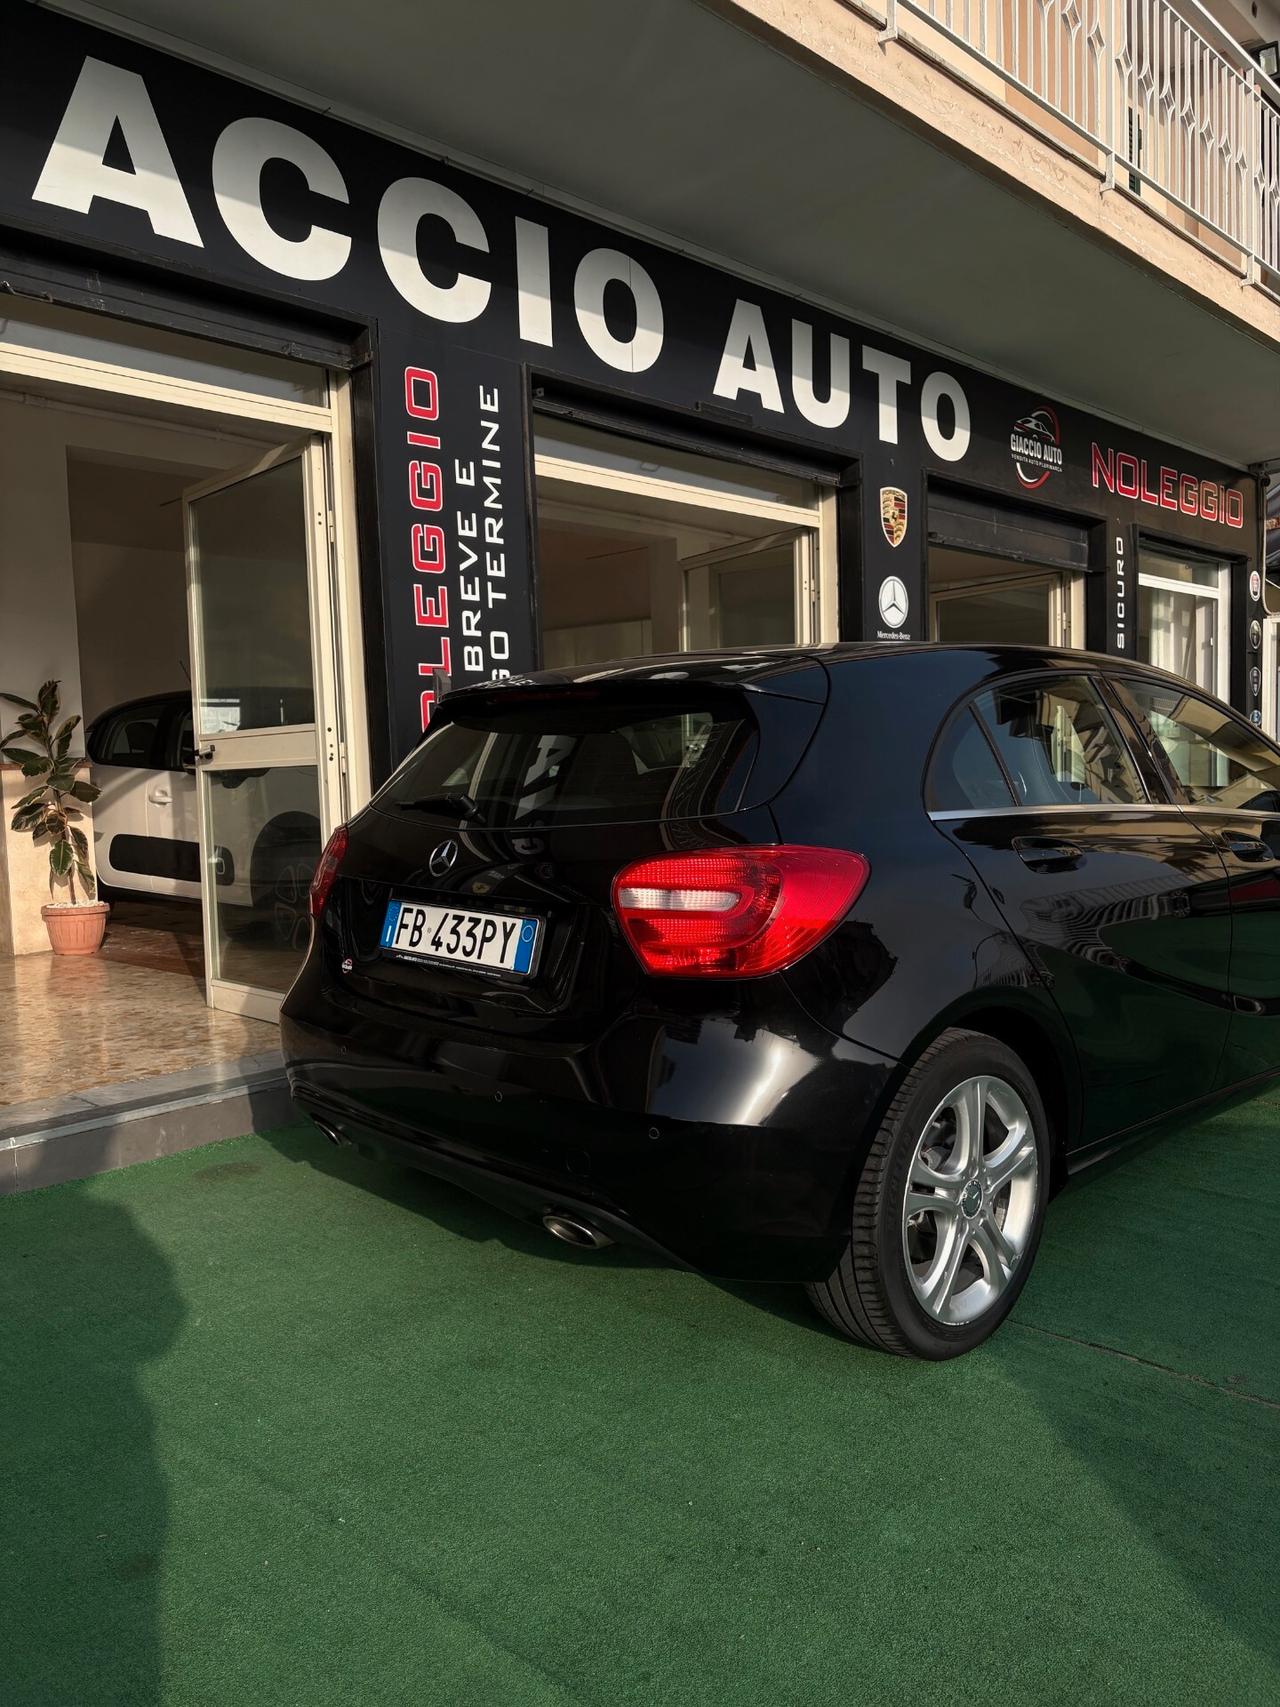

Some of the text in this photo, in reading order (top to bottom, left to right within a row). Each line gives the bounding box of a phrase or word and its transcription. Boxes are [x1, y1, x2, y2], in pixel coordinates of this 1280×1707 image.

[32, 55, 971, 462] ACCIO AUTO
[479, 384, 507, 609] TERMINE
[1010, 433, 1063, 465] GIACCIO AUTO
[1091, 441, 1244, 529] NOLEGGIO
[455, 458, 484, 672] BREVE E
[1116, 536, 1125, 650] SICURO
[877, 630, 911, 641] Mercedes-Benz
